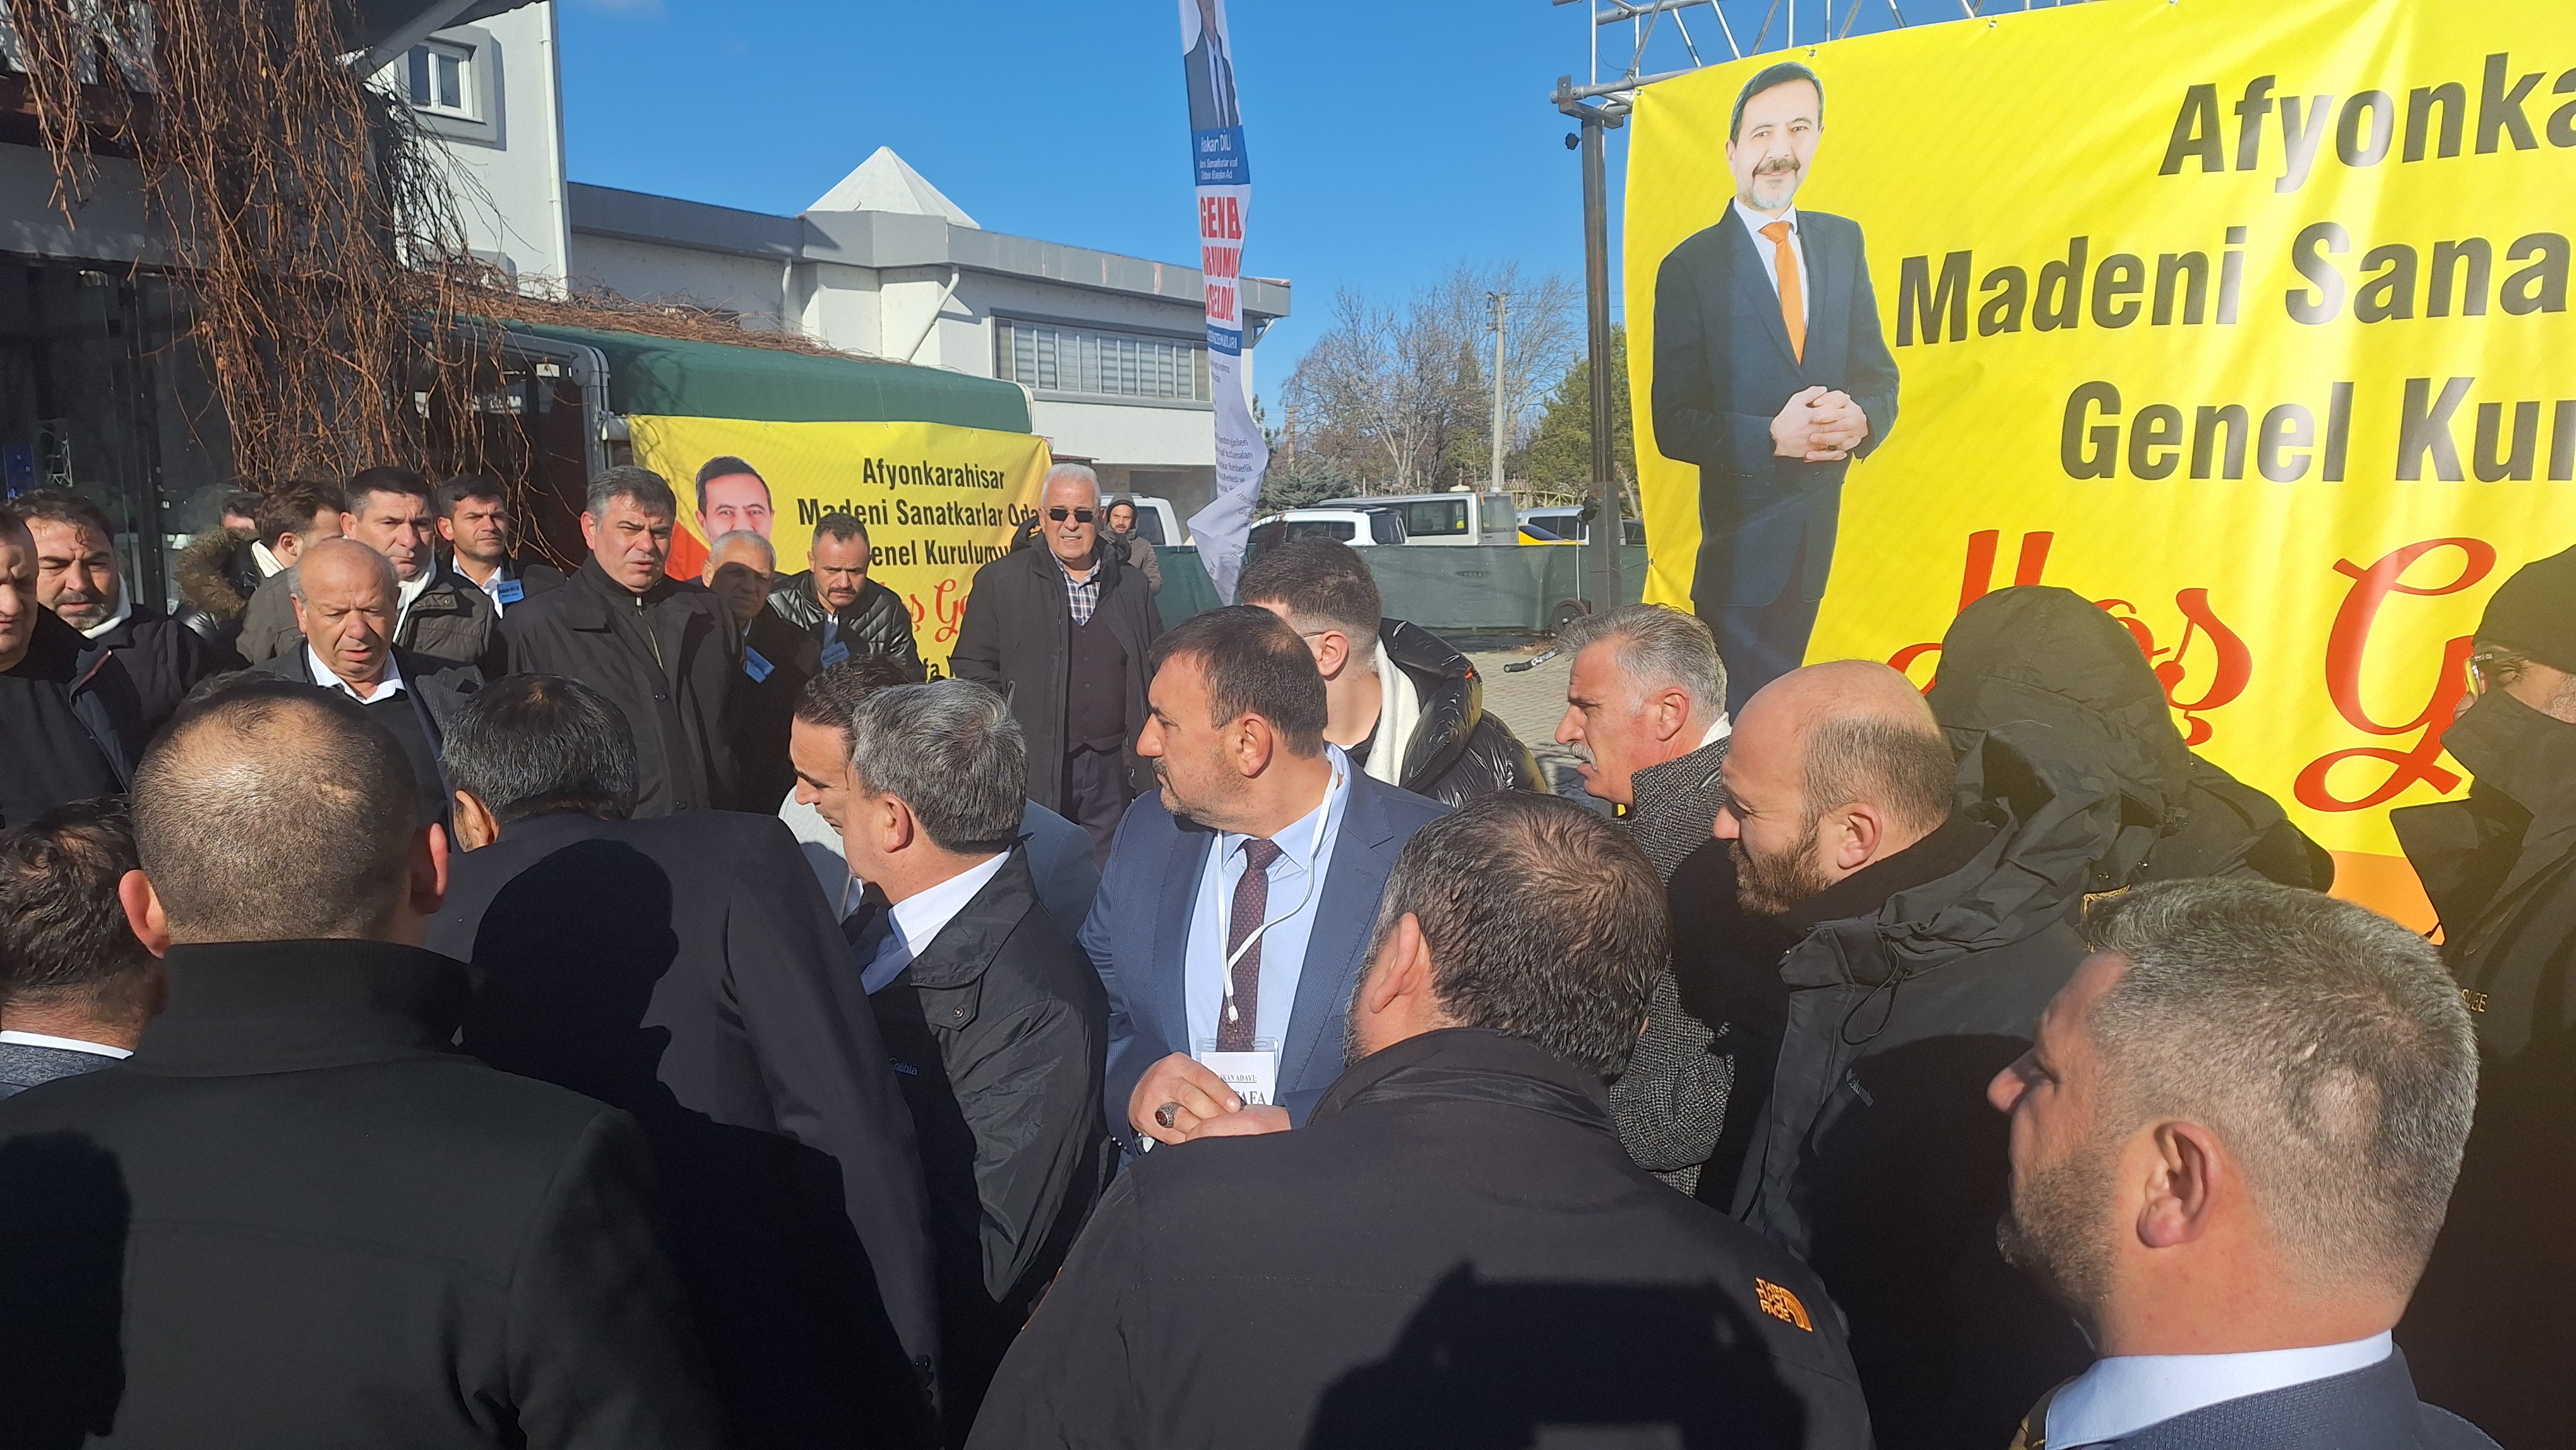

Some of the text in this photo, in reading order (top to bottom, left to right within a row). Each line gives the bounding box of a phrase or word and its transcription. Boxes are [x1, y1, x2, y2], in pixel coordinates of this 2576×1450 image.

[1896, 225, 2245, 347] Madeni
[2061, 381, 2353, 482] Genel
[862, 457, 1005, 491] Afyonkarahisar
[896, 498, 1003, 527] Sanatkarlar
[869, 539, 917, 566] enel
[1759, 1298, 1792, 1324] FACE
